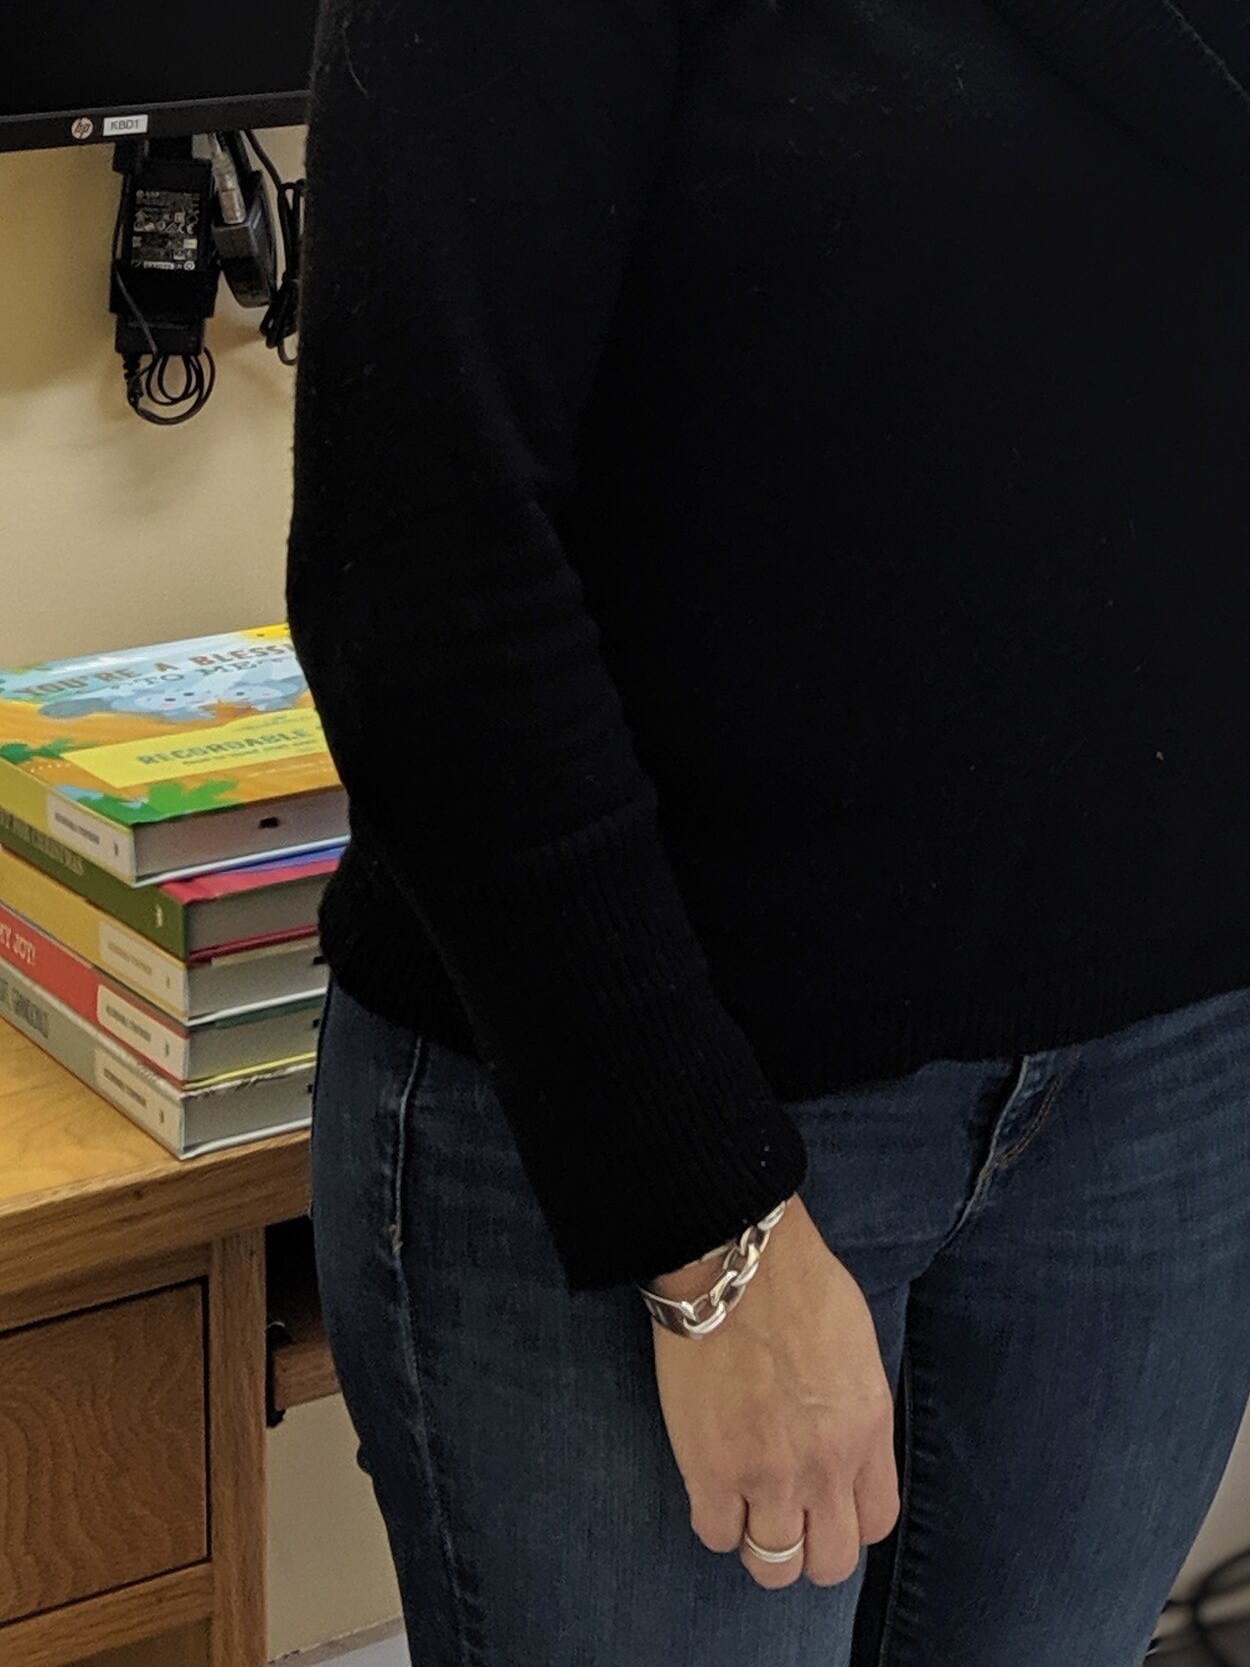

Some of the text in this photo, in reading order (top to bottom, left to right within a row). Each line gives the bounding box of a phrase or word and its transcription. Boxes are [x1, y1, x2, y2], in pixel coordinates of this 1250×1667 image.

[73, 118, 92, 139] hp
[12, 668, 142, 696] YOU'RE
[154, 661, 179, 672] A
[138, 672, 185, 685] TO
[137, 728, 307, 766] RECORDABLE
